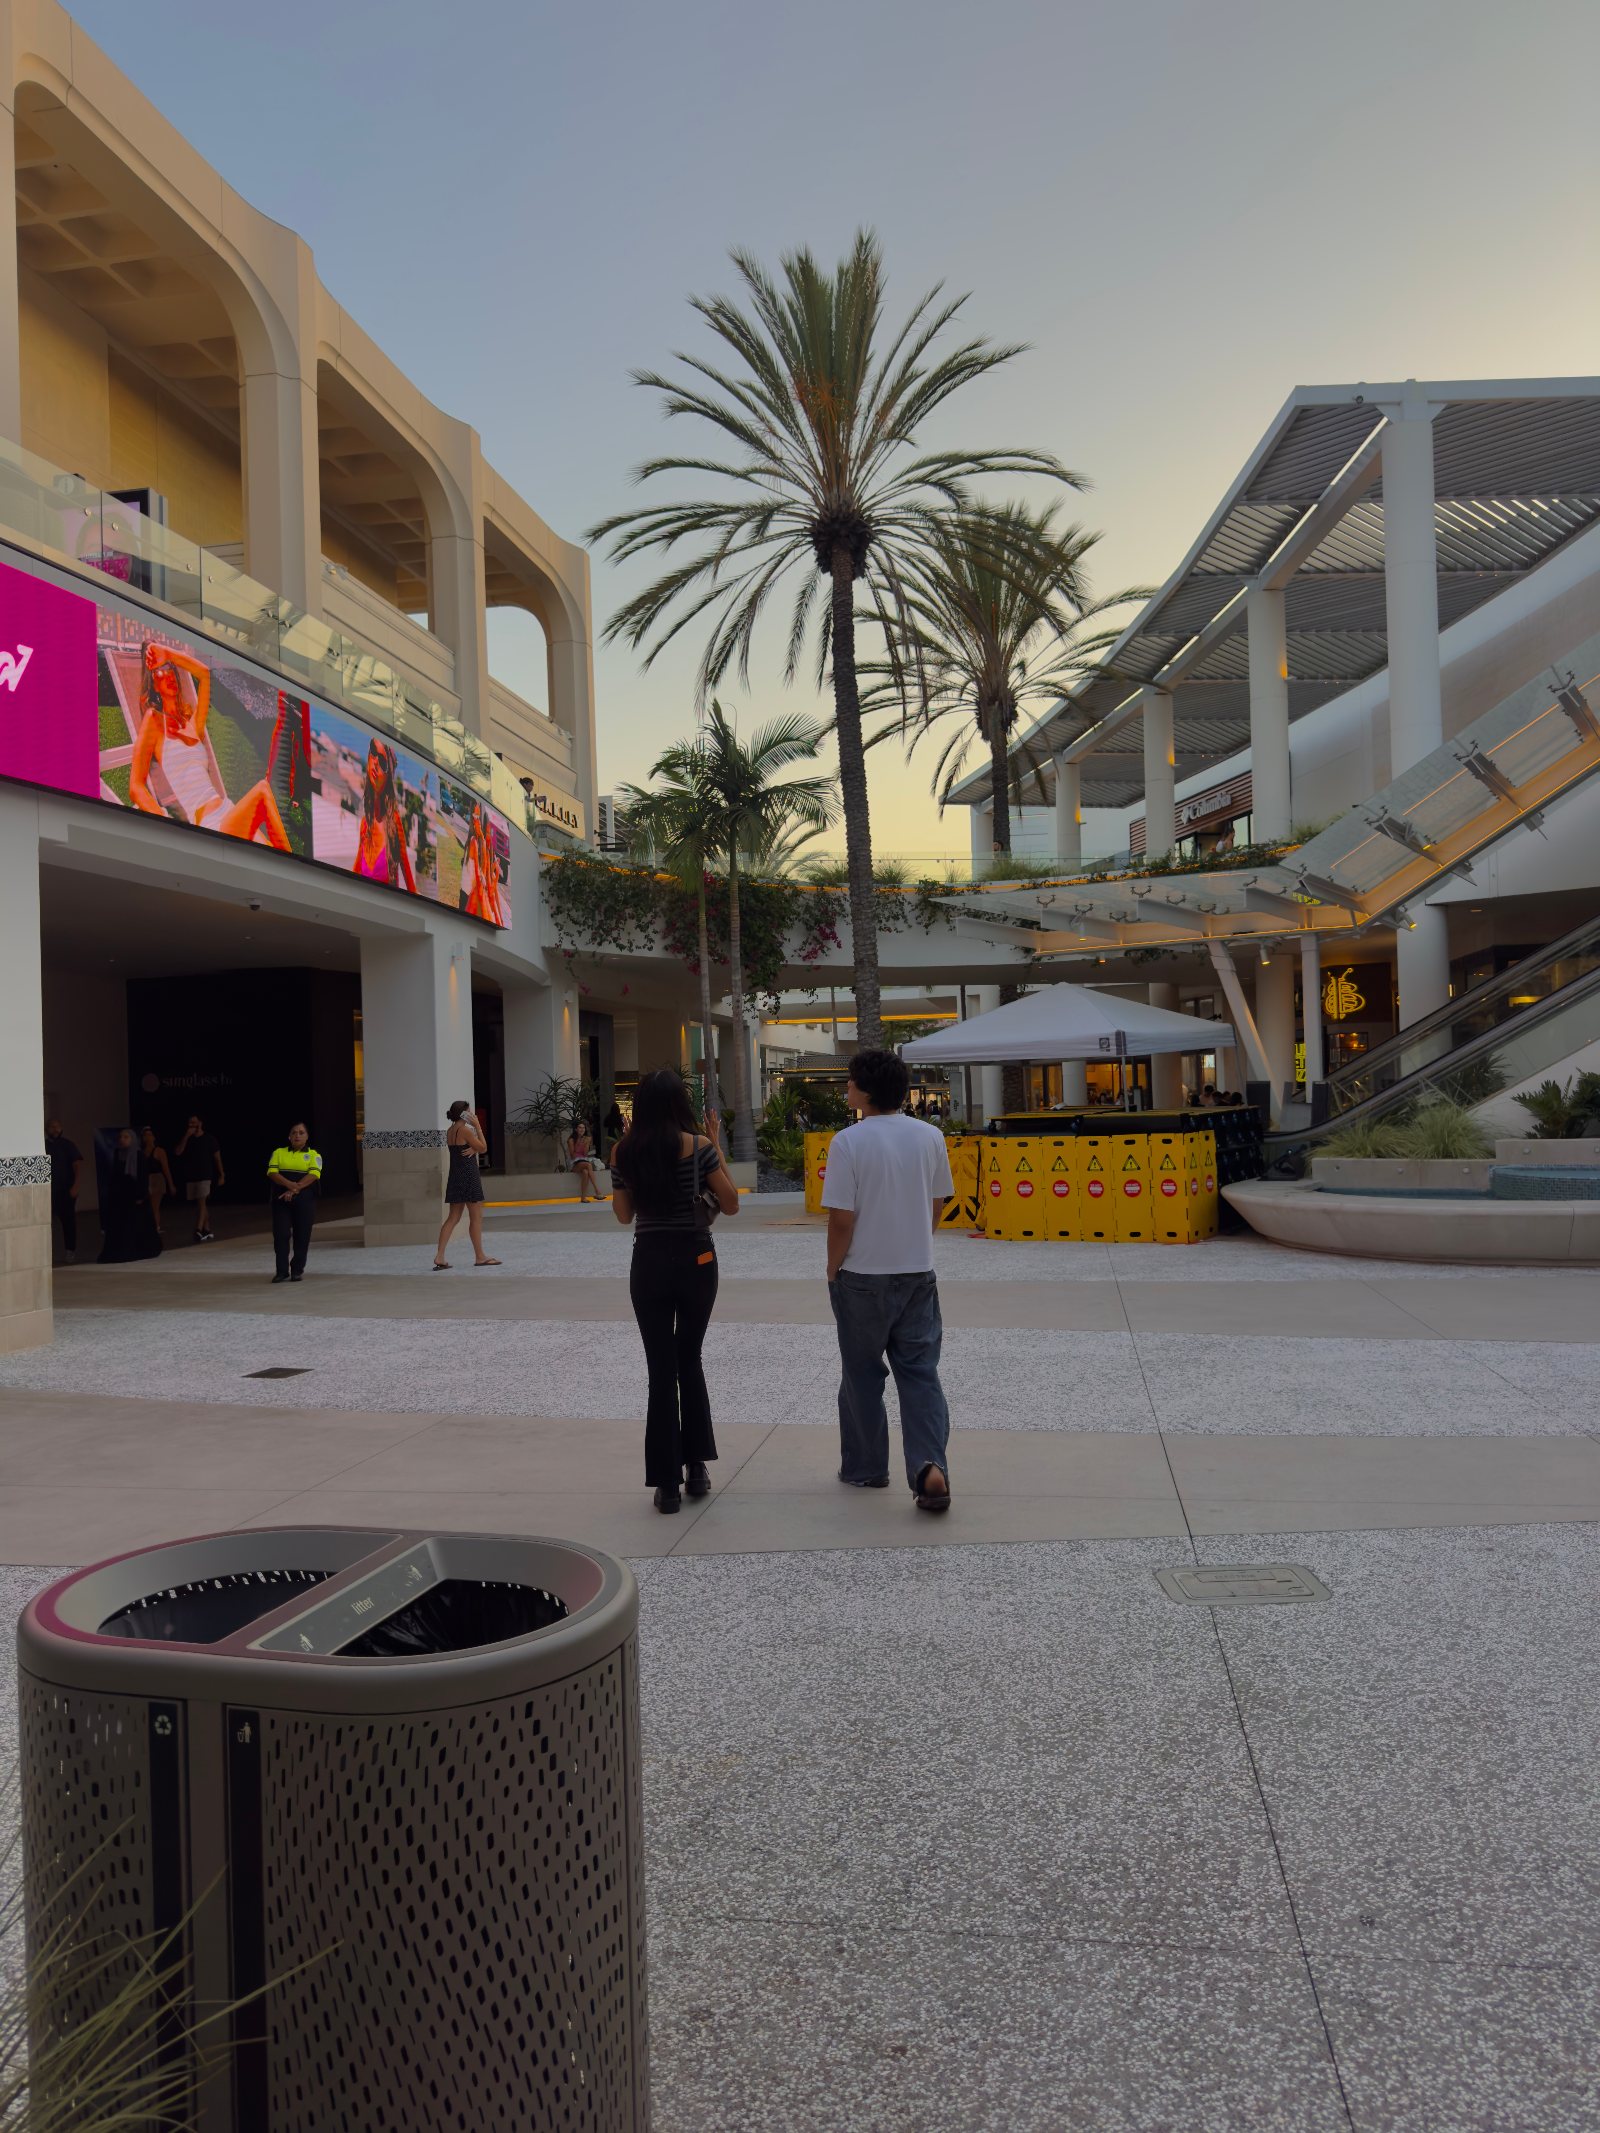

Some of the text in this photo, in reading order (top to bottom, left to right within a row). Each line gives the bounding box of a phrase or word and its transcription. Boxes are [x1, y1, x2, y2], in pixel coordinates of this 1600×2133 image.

[1189, 791, 1232, 820] Columbia
[162, 1072, 217, 1088] sunglass
[351, 1597, 375, 1616] litter
